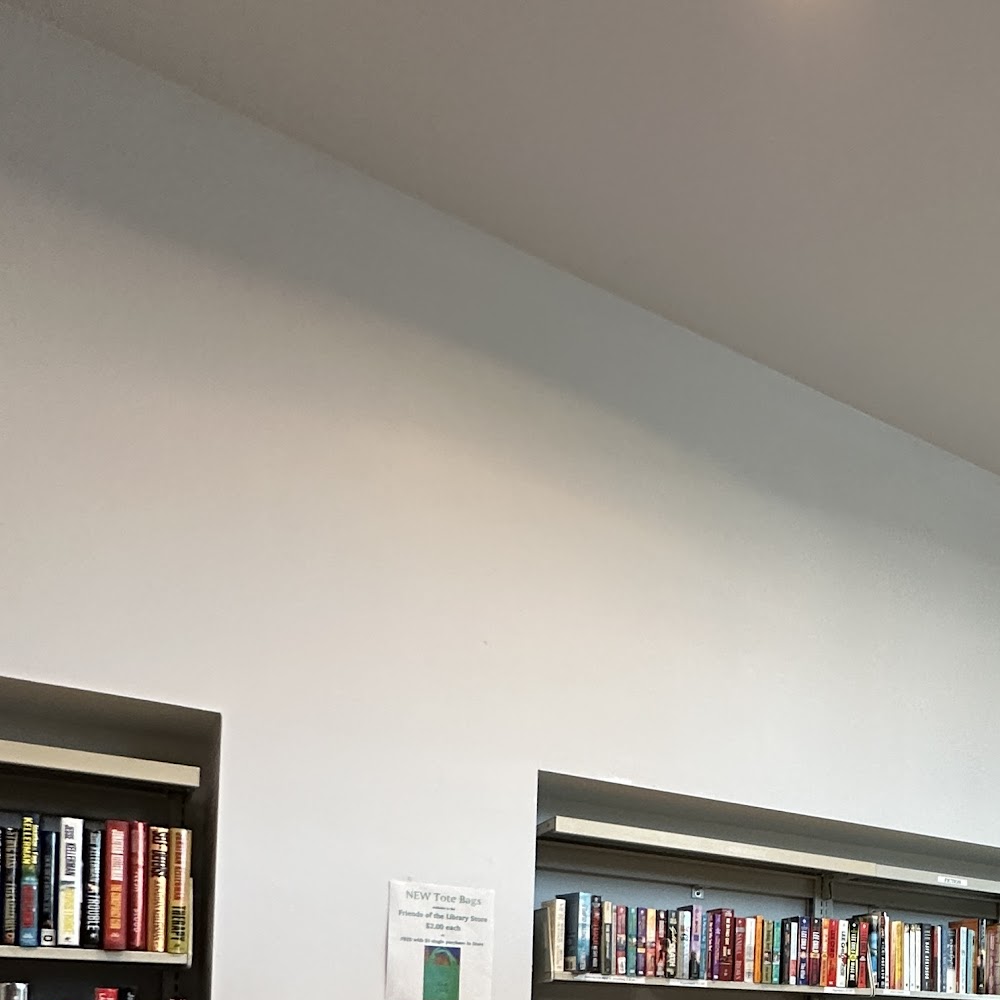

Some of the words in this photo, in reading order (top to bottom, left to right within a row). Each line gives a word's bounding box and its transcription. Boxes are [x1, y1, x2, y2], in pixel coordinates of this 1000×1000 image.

[22, 817, 33, 865] KELLERMAN
[65, 825, 75, 840] JESSE
[65, 843, 76, 876] KELLERMAN
[87, 894, 100, 930] TROUBLE
[406, 890, 431, 900] NEW
[433, 892, 457, 903] Tote
[459, 895, 482, 906] Bags
[171, 906, 187, 941] THERAPY
[398, 909, 423, 918] Friends
[434, 912, 444, 920] the
[446, 913, 468, 922] Library
